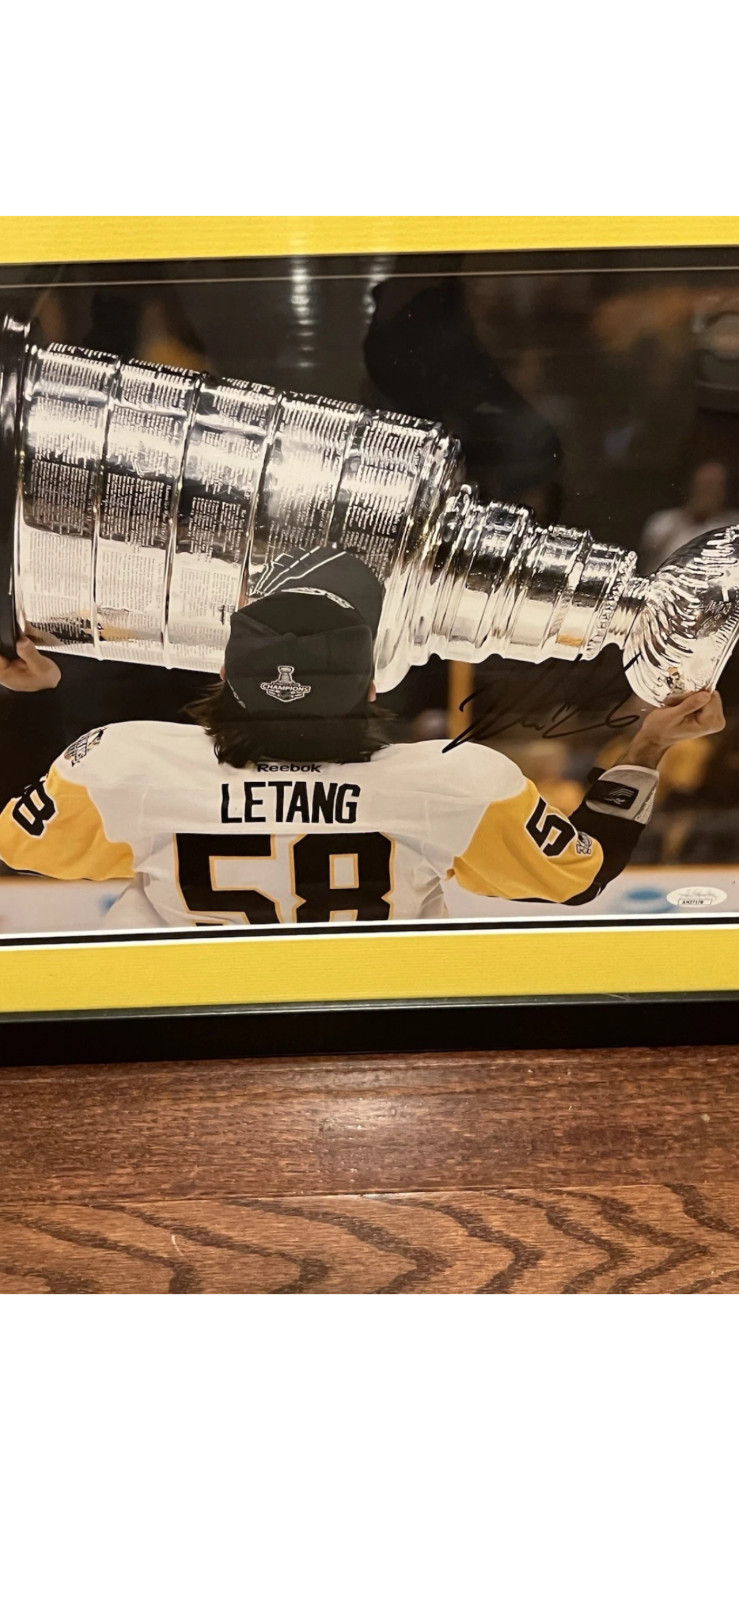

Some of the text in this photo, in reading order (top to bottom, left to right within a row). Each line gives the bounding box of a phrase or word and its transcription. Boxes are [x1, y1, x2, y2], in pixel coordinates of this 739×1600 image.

[260, 683, 311, 693] CHAMPIONS
[257, 763, 321, 772] Reebok
[221, 781, 361, 824] LETANG
[525, 796, 576, 858] 5
[173, 832, 395, 925] 58
